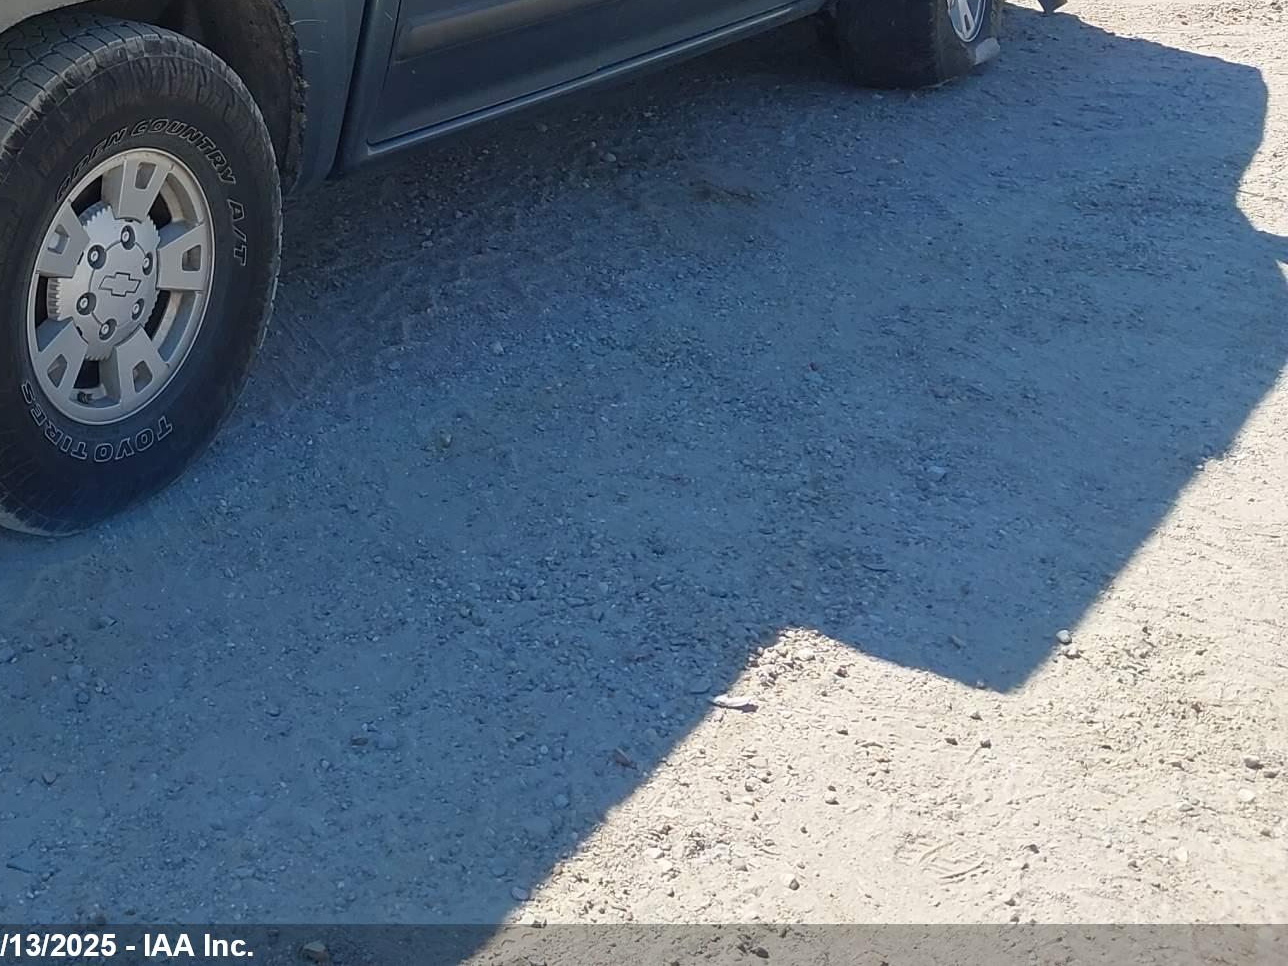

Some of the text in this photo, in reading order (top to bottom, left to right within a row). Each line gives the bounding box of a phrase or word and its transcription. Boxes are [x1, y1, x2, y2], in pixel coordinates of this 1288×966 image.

[131, 118, 237, 185] COUNTRY
[226, 198, 247, 266] A/T
[20, 380, 174, 463] TOYO TIRES
